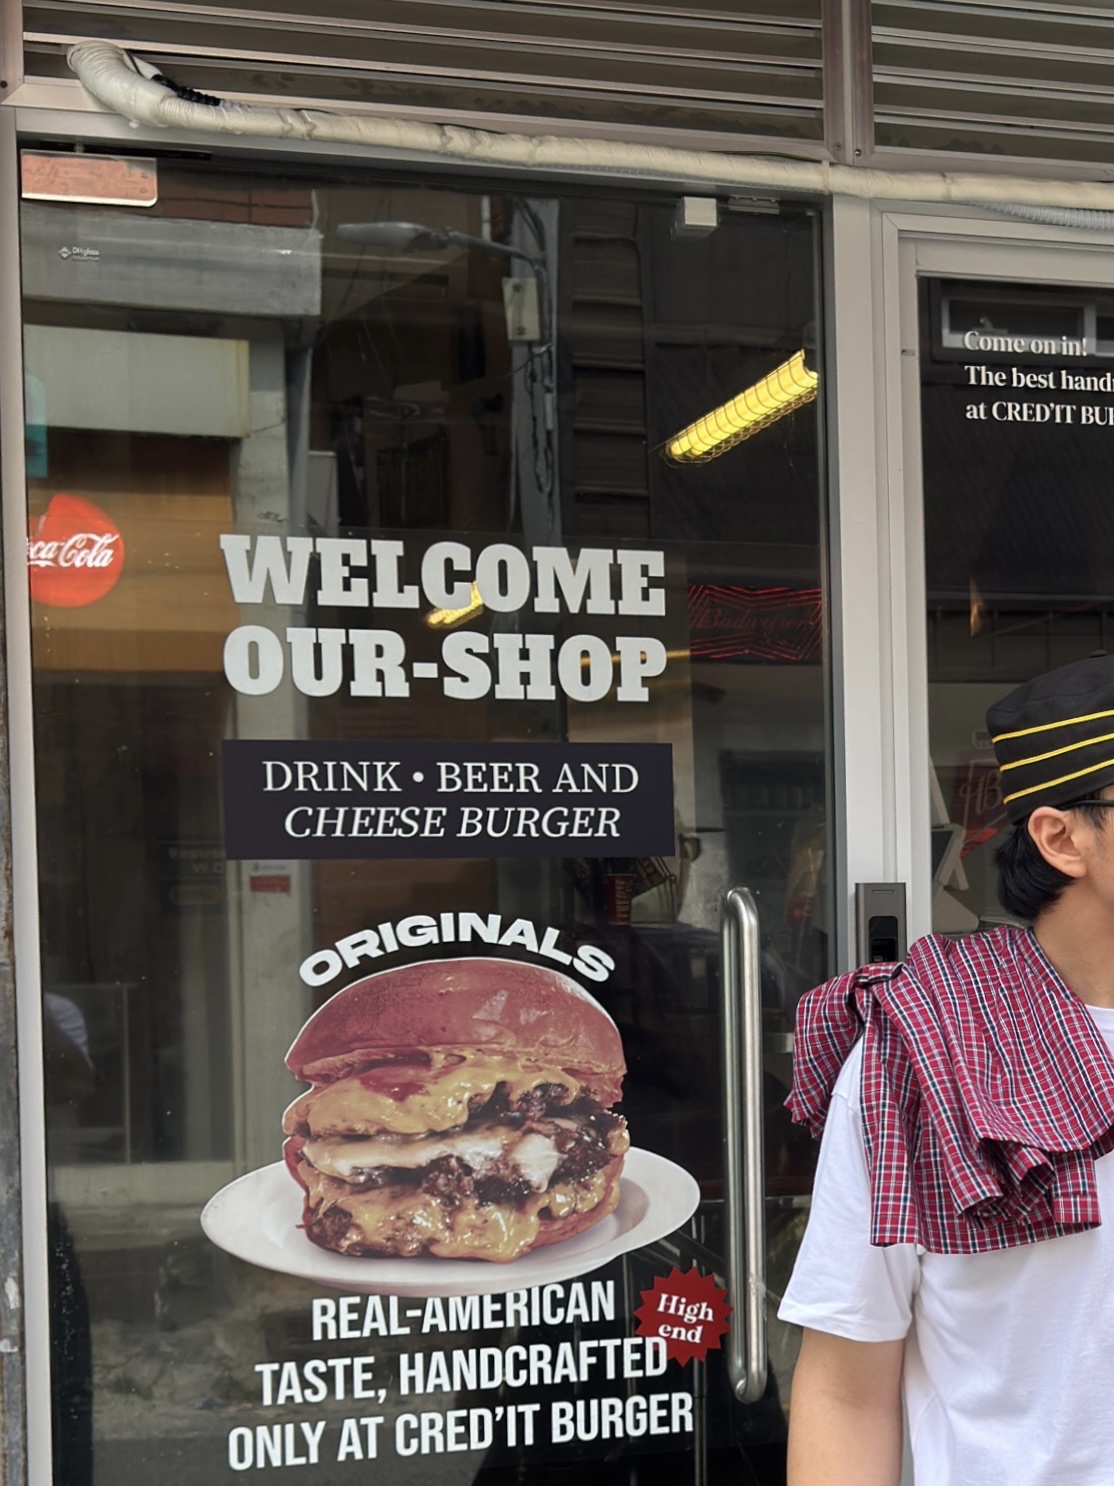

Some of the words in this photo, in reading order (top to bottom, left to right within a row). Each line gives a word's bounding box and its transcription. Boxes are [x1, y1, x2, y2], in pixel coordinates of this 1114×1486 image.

[964, 331, 1024, 354] Come
[1030, 336, 1057, 355] on
[1061, 336, 1087, 356] in!
[964, 365, 1007, 387] The
[1011, 367, 1056, 389] best
[965, 402, 987, 420] at
[992, 401, 1077, 424] CRED'IT
[220, 535, 665, 617] WELCOME
[224, 625, 666, 702] OUR-SHOP
[262, 761, 402, 792] DRINK
[436, 762, 543, 793] BEER
[552, 763, 639, 793] AND
[284, 806, 447, 838] CHEESE
[456, 806, 621, 838] BURGER
[299, 912, 615, 988] ORIGINALS
[312, 1280, 614, 1341] REAL-AMERICAN
[657, 1293, 713, 1324] High
[658, 1322, 703, 1344] end
[254, 1355, 387, 1406] TASTE,
[400, 1335, 667, 1395] HANDCRAFTED
[228, 1420, 326, 1471] ONLY
[337, 1416, 385, 1462] AT
[395, 1403, 541, 1457] CRED'IT
[551, 1391, 693, 1439] BURGER
